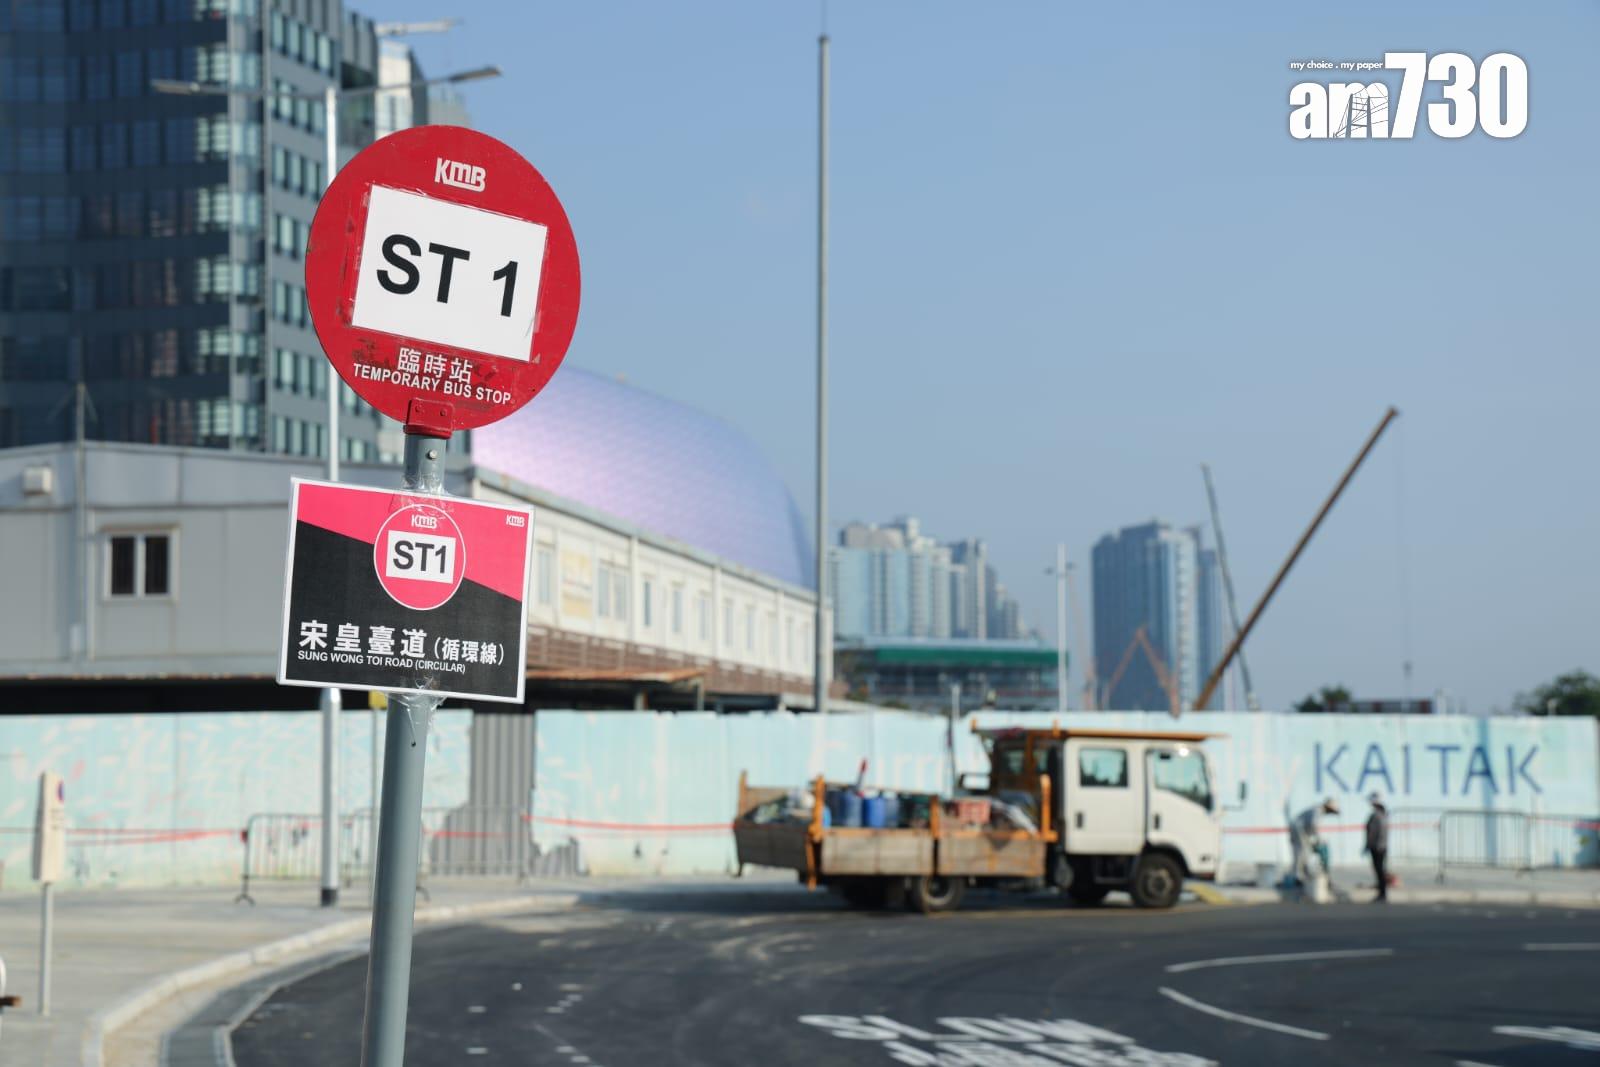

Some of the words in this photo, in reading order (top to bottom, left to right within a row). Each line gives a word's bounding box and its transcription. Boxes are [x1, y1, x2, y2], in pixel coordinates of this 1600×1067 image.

[434, 157, 486, 192] KMB
[376, 234, 470, 303] ST
[493, 260, 518, 317] 1
[397, 347, 473, 384] 臨時站
[353, 363, 440, 391] TEMPORARY
[444, 380, 472, 398] BUS
[475, 387, 511, 405] STOP
[411, 514, 438, 529] KMB
[506, 514, 525, 527] KMB
[393, 540, 447, 574] ST1
[297, 650, 328, 662] SUNG
[330, 653, 364, 665] WONG
[366, 655, 383, 666] TOI
[385, 657, 413, 669] ROAD
[415, 659, 466, 674] (CIRCULAR)
[1313, 741, 1412, 793] KAI
[1426, 743, 1543, 795] TAK
